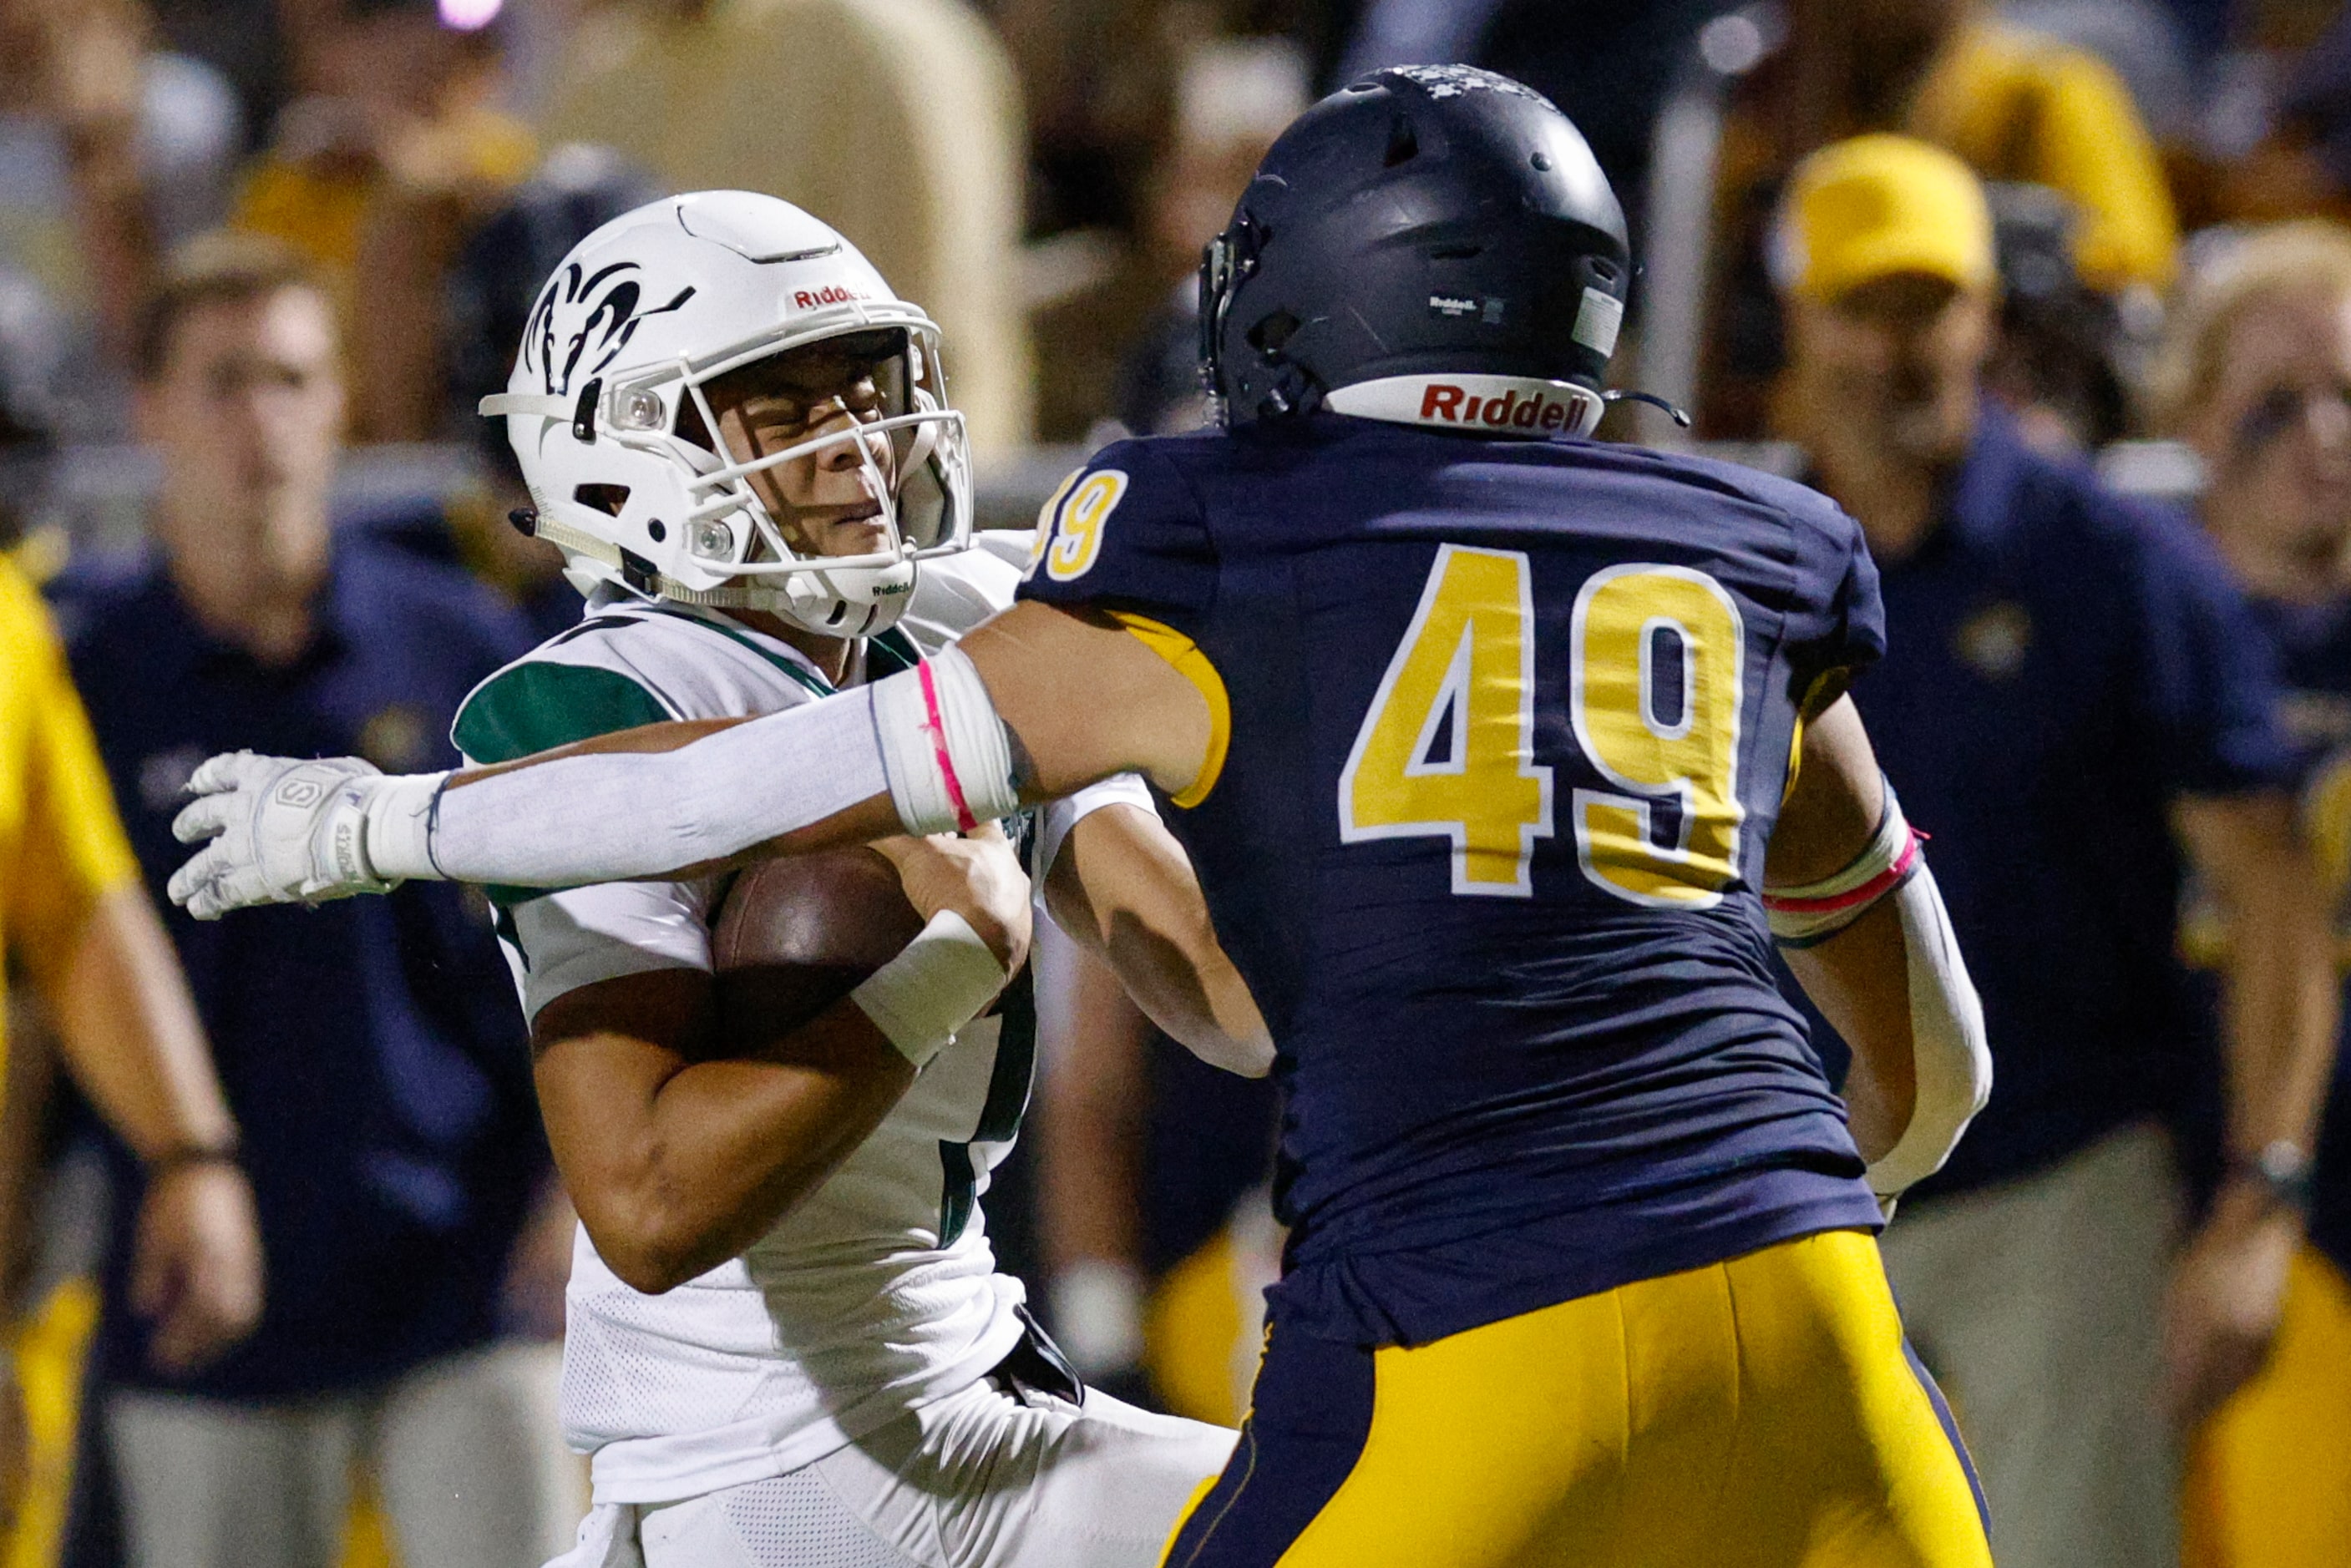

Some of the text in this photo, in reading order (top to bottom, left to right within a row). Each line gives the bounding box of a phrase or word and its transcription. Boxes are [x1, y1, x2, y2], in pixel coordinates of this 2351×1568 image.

[1421, 384, 1588, 432] Riddell
[1021, 466, 1129, 582] 9
[872, 582, 909, 596] Riddell
[1338, 543, 1746, 908] 49
